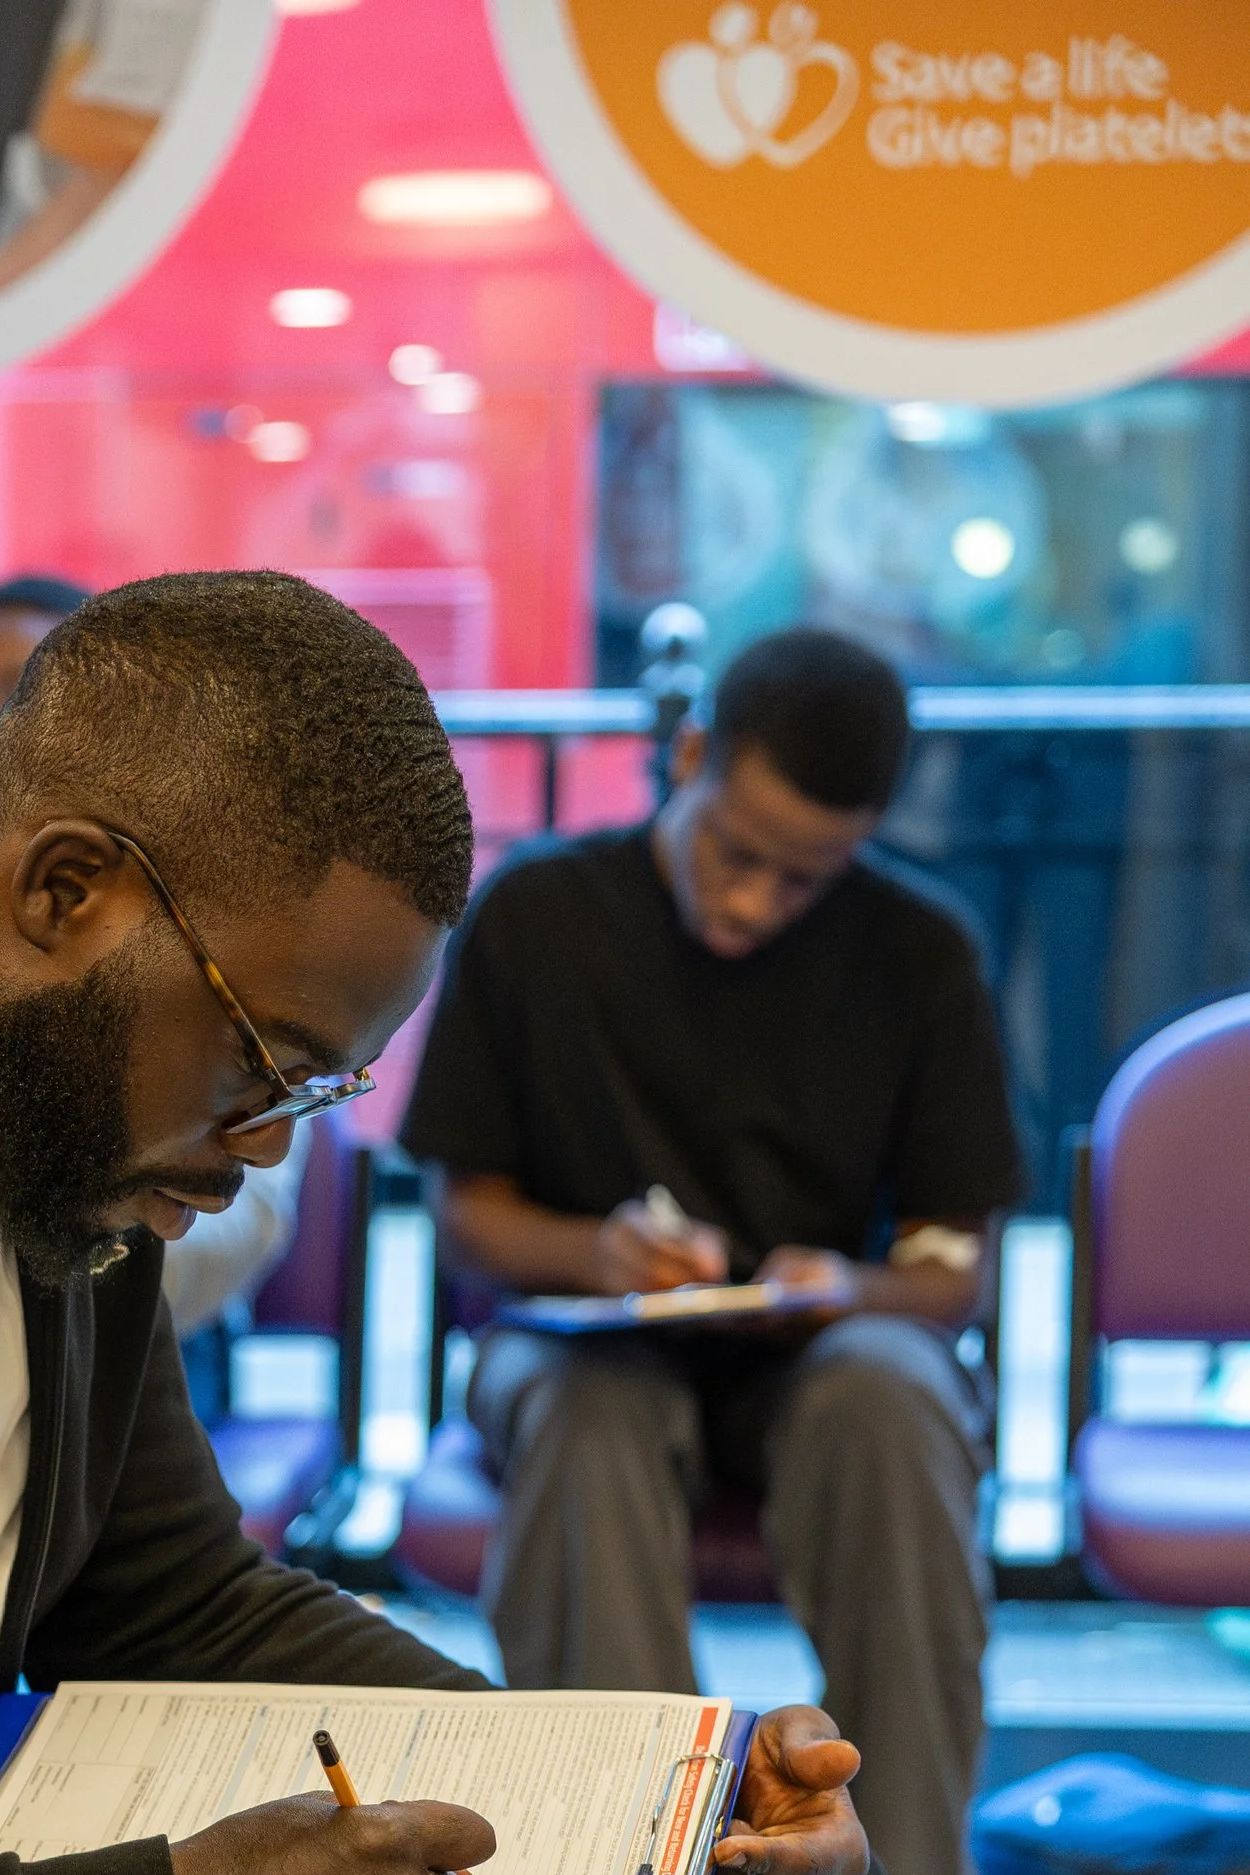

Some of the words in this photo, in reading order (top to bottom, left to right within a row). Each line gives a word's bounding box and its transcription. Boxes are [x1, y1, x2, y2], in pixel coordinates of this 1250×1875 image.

[869, 40, 1017, 101] Save
[1020, 50, 1063, 99] a
[1068, 34, 1170, 98] life
[866, 106, 1005, 168] Give
[671, 1830, 682, 1842] and
